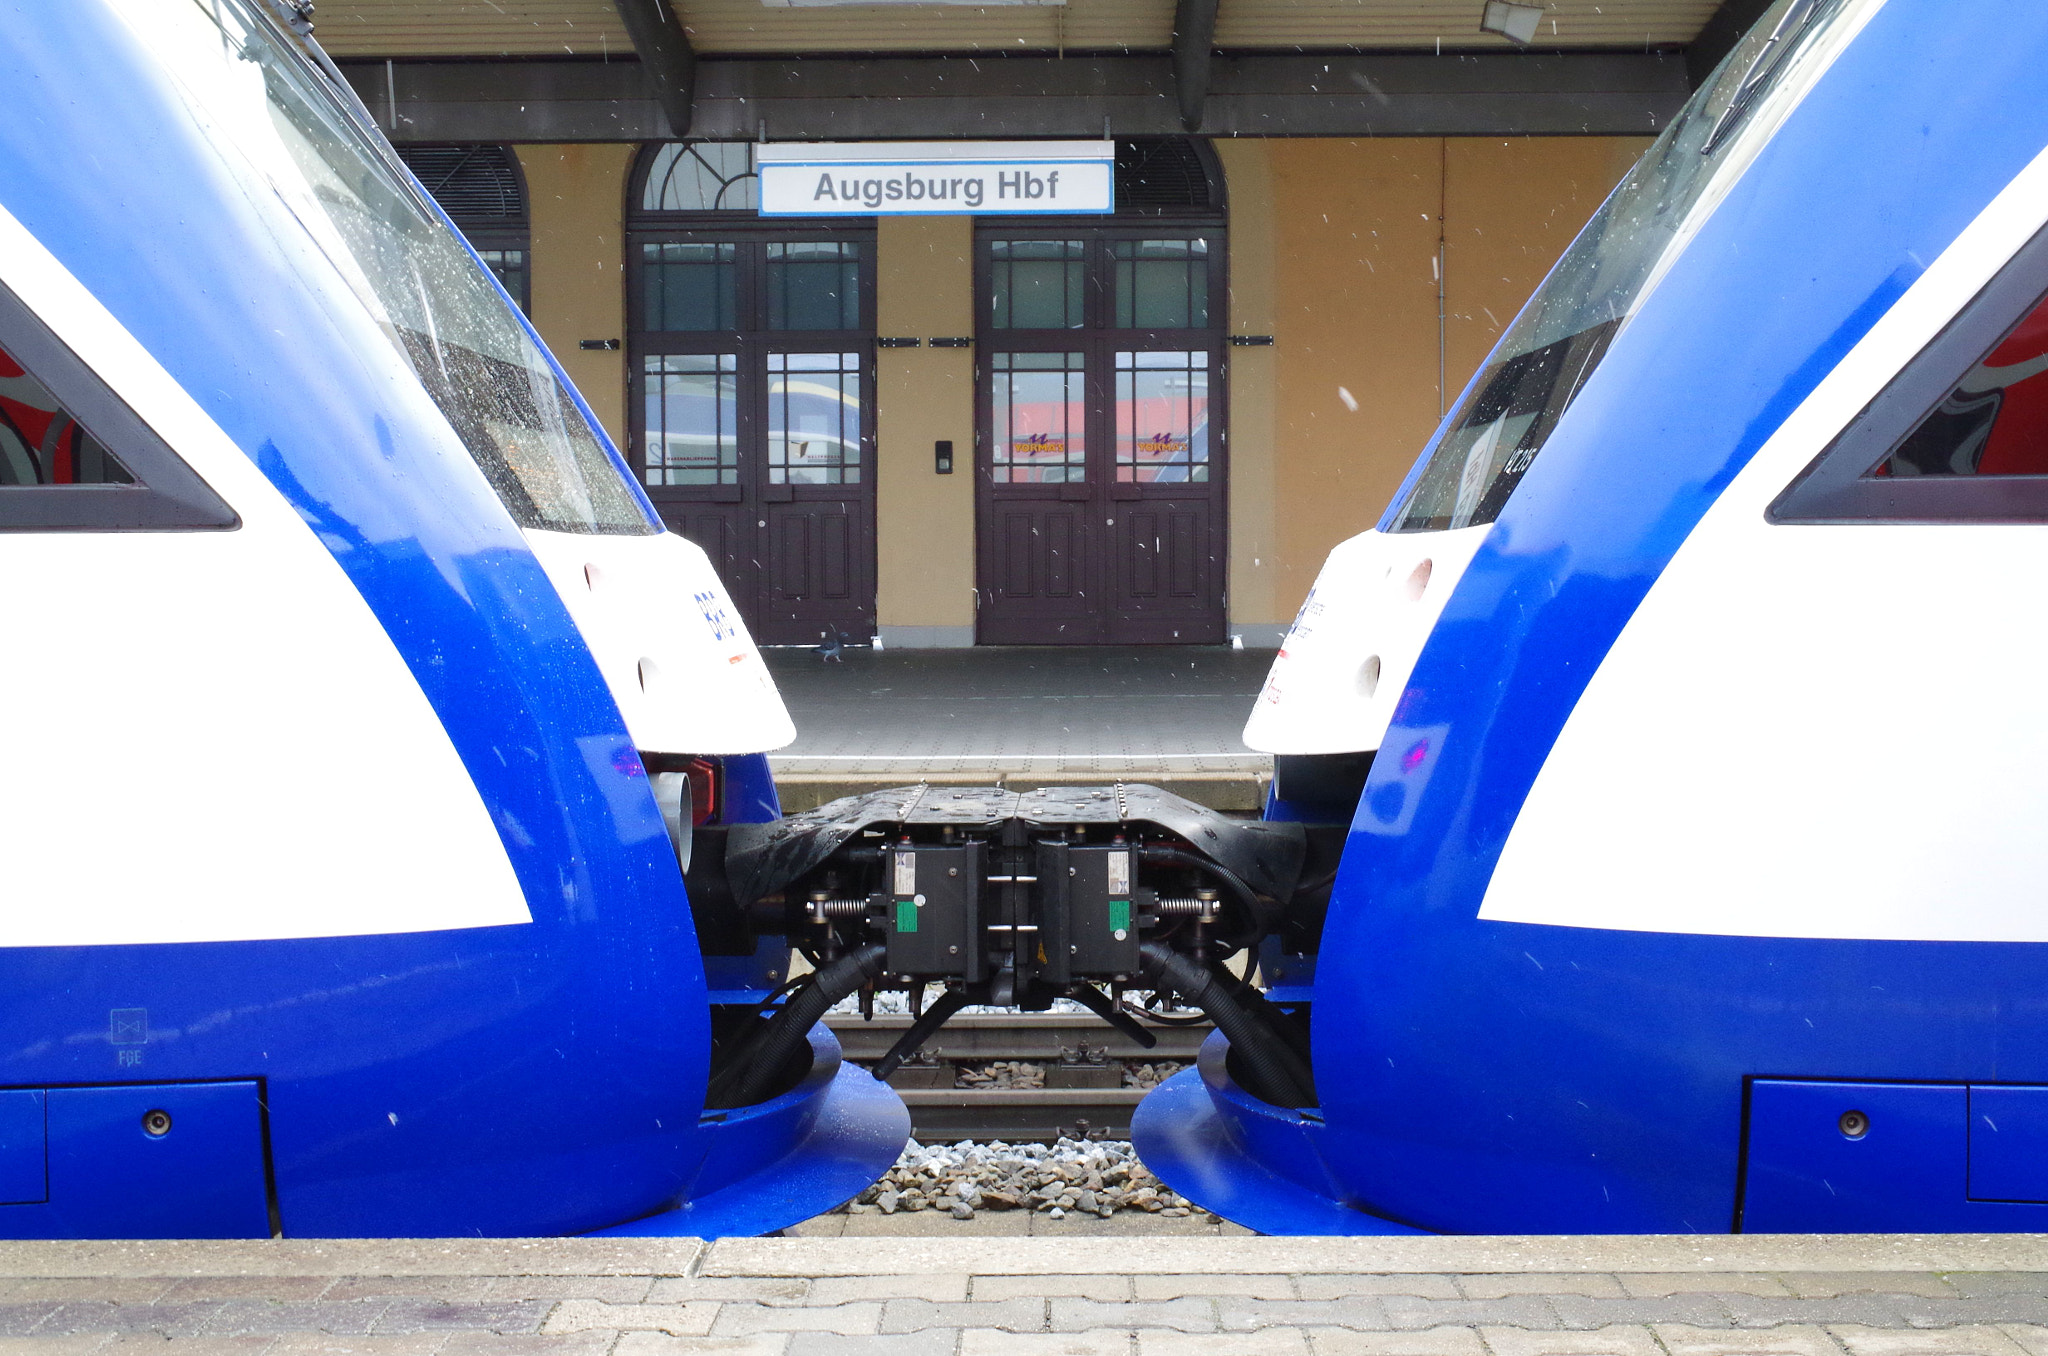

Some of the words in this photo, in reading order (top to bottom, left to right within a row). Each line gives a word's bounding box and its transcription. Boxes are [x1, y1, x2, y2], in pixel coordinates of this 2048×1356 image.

[814, 172, 984, 207] Augsburg
[998, 171, 1059, 199] Hbf
[1014, 443, 1064, 453] YORMA'S
[1137, 442, 1188, 452] YORMA'S
